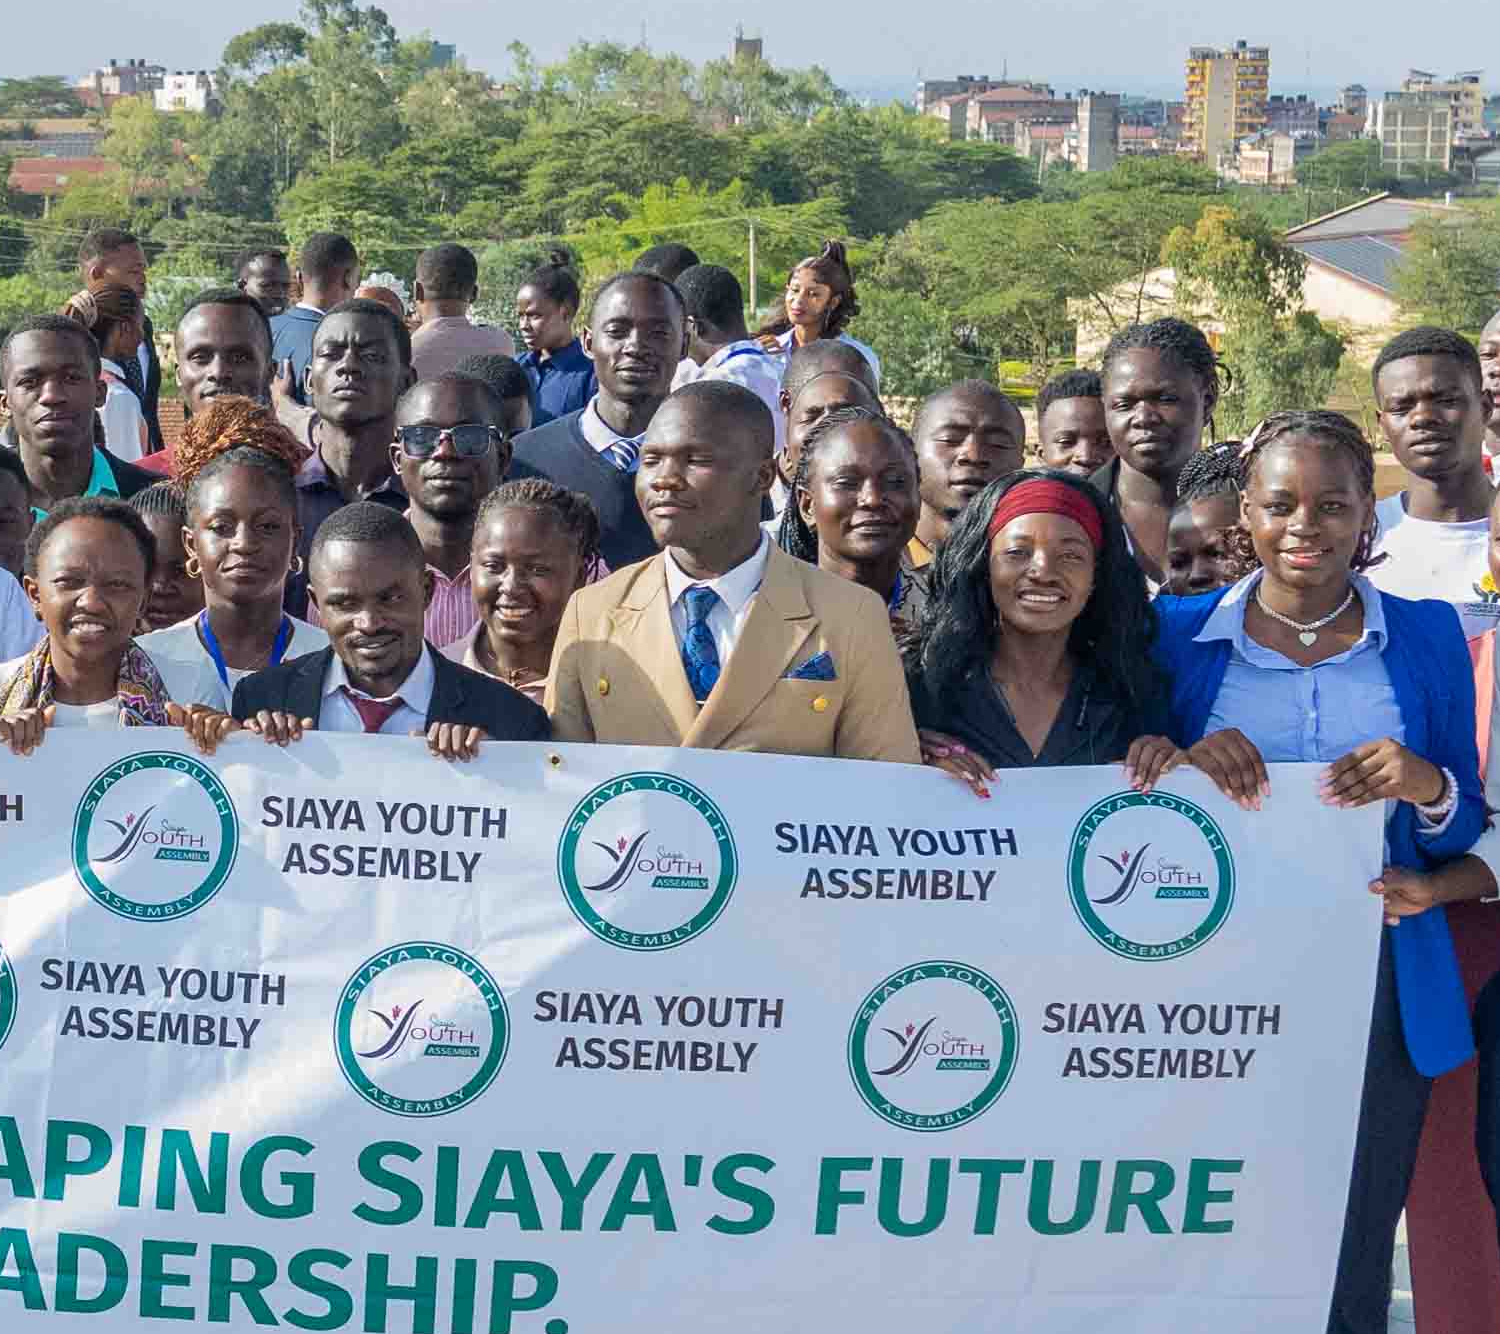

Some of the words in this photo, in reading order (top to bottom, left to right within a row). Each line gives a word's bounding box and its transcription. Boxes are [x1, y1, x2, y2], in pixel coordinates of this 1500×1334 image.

[84, 759, 143, 812] SIAYA
[158, 758, 229, 817] YOUTH
[261, 795, 366, 832] SIAYA
[375, 801, 507, 839] YOUTH
[570, 779, 635, 835] SIAYA
[651, 778, 727, 842] YOUTH
[1078, 795, 1130, 848] SIAYA
[1142, 792, 1222, 851] YOUTH
[775, 822, 880, 857] SIAYA
[887, 827, 1018, 857] YOUTH
[282, 842, 482, 883] ASSEMBLY
[98, 887, 196, 915] ASSEMBLY
[799, 867, 996, 901] ASSEMBLY
[593, 918, 695, 944] ASSEMBLY
[1103, 930, 1199, 954] ASSEMBLY
[40, 958, 146, 996] SIAYA
[157, 966, 286, 1006] YOUTH
[347, 949, 410, 1002] SIAYA
[425, 948, 501, 1012] YOUTH
[861, 968, 925, 1022] SIAYA
[942, 967, 1011, 1024] YOUTH
[60, 1005, 261, 1049] ASSEMBLY
[533, 991, 642, 1026] SIAYA
[655, 996, 784, 1029] YOUTH
[1042, 1002, 1146, 1034] SIAYA
[1157, 1003, 1281, 1036] YOUTH
[555, 1037, 758, 1073] ASSEMBLY
[1062, 1046, 1256, 1079] ASSEMBLY
[366, 1084, 467, 1110] ASSEMBLY
[879, 1100, 976, 1125] ASSEMBLY
[351, 1140, 777, 1237] SIAYA'S
[814, 1156, 1244, 1237] FUTURE
